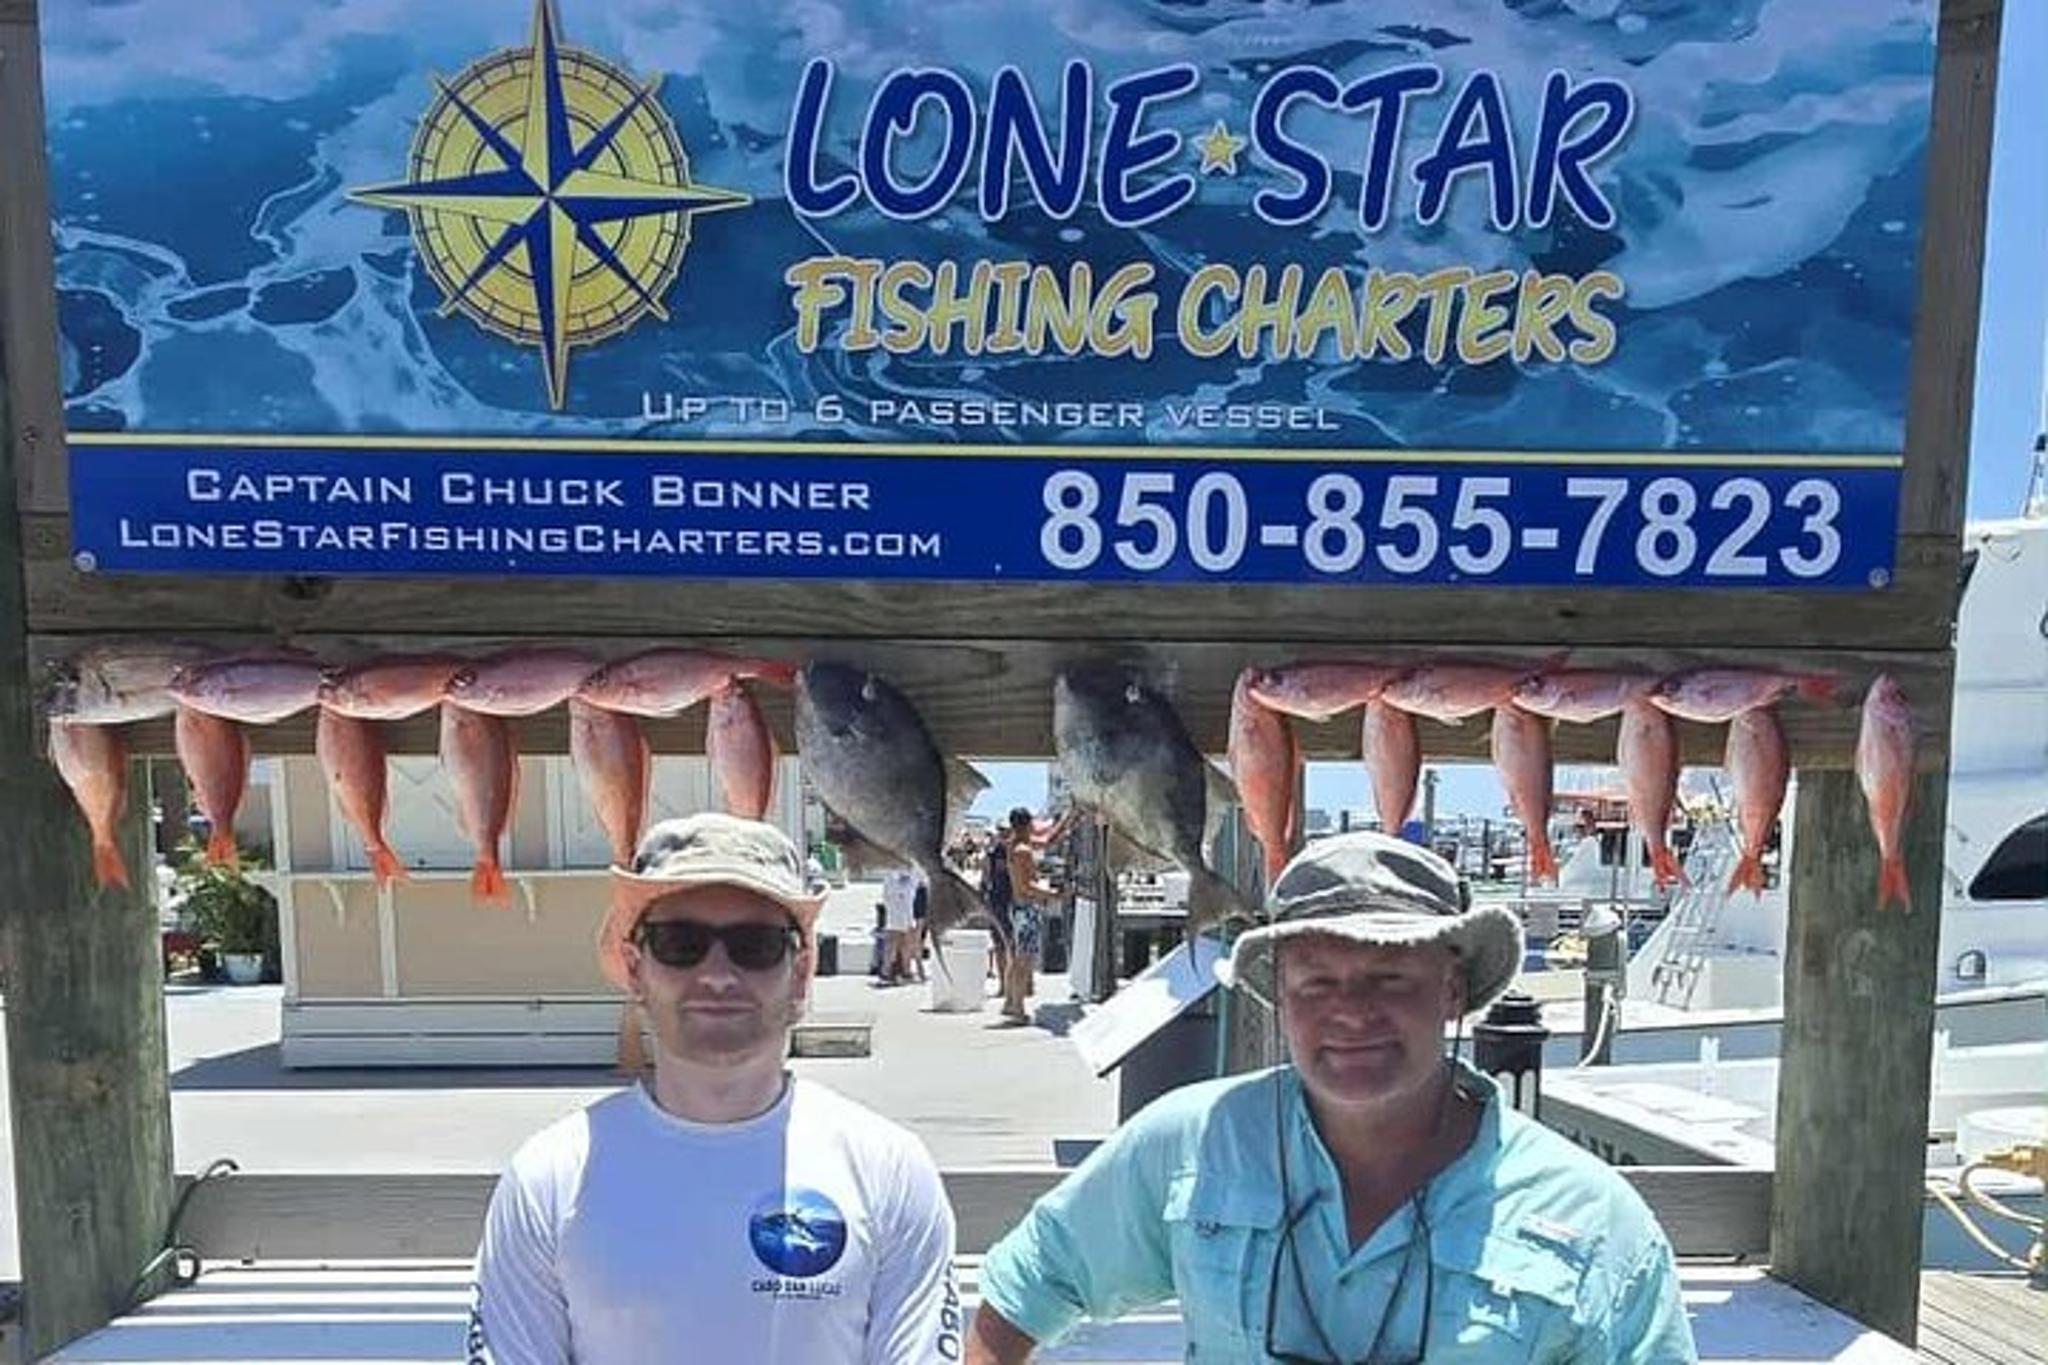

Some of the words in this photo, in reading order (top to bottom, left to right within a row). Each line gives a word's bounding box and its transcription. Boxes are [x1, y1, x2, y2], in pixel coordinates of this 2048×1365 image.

[785, 57, 1199, 226] LONE
[1248, 63, 1634, 231] STAR
[786, 256, 1157, 358] FISHING
[1178, 262, 1625, 364] CHARTERS
[642, 391, 708, 422] UP
[729, 397, 789, 423] TO
[815, 394, 846, 422] 6
[870, 399, 1146, 429] PASSENGER
[1164, 403, 1341, 431] VESSEL
[187, 468, 413, 504] CAPTAIN
[440, 472, 626, 508] CHUCK
[651, 474, 872, 511] BONNER
[1040, 470, 1844, 578] 850-855-7823
